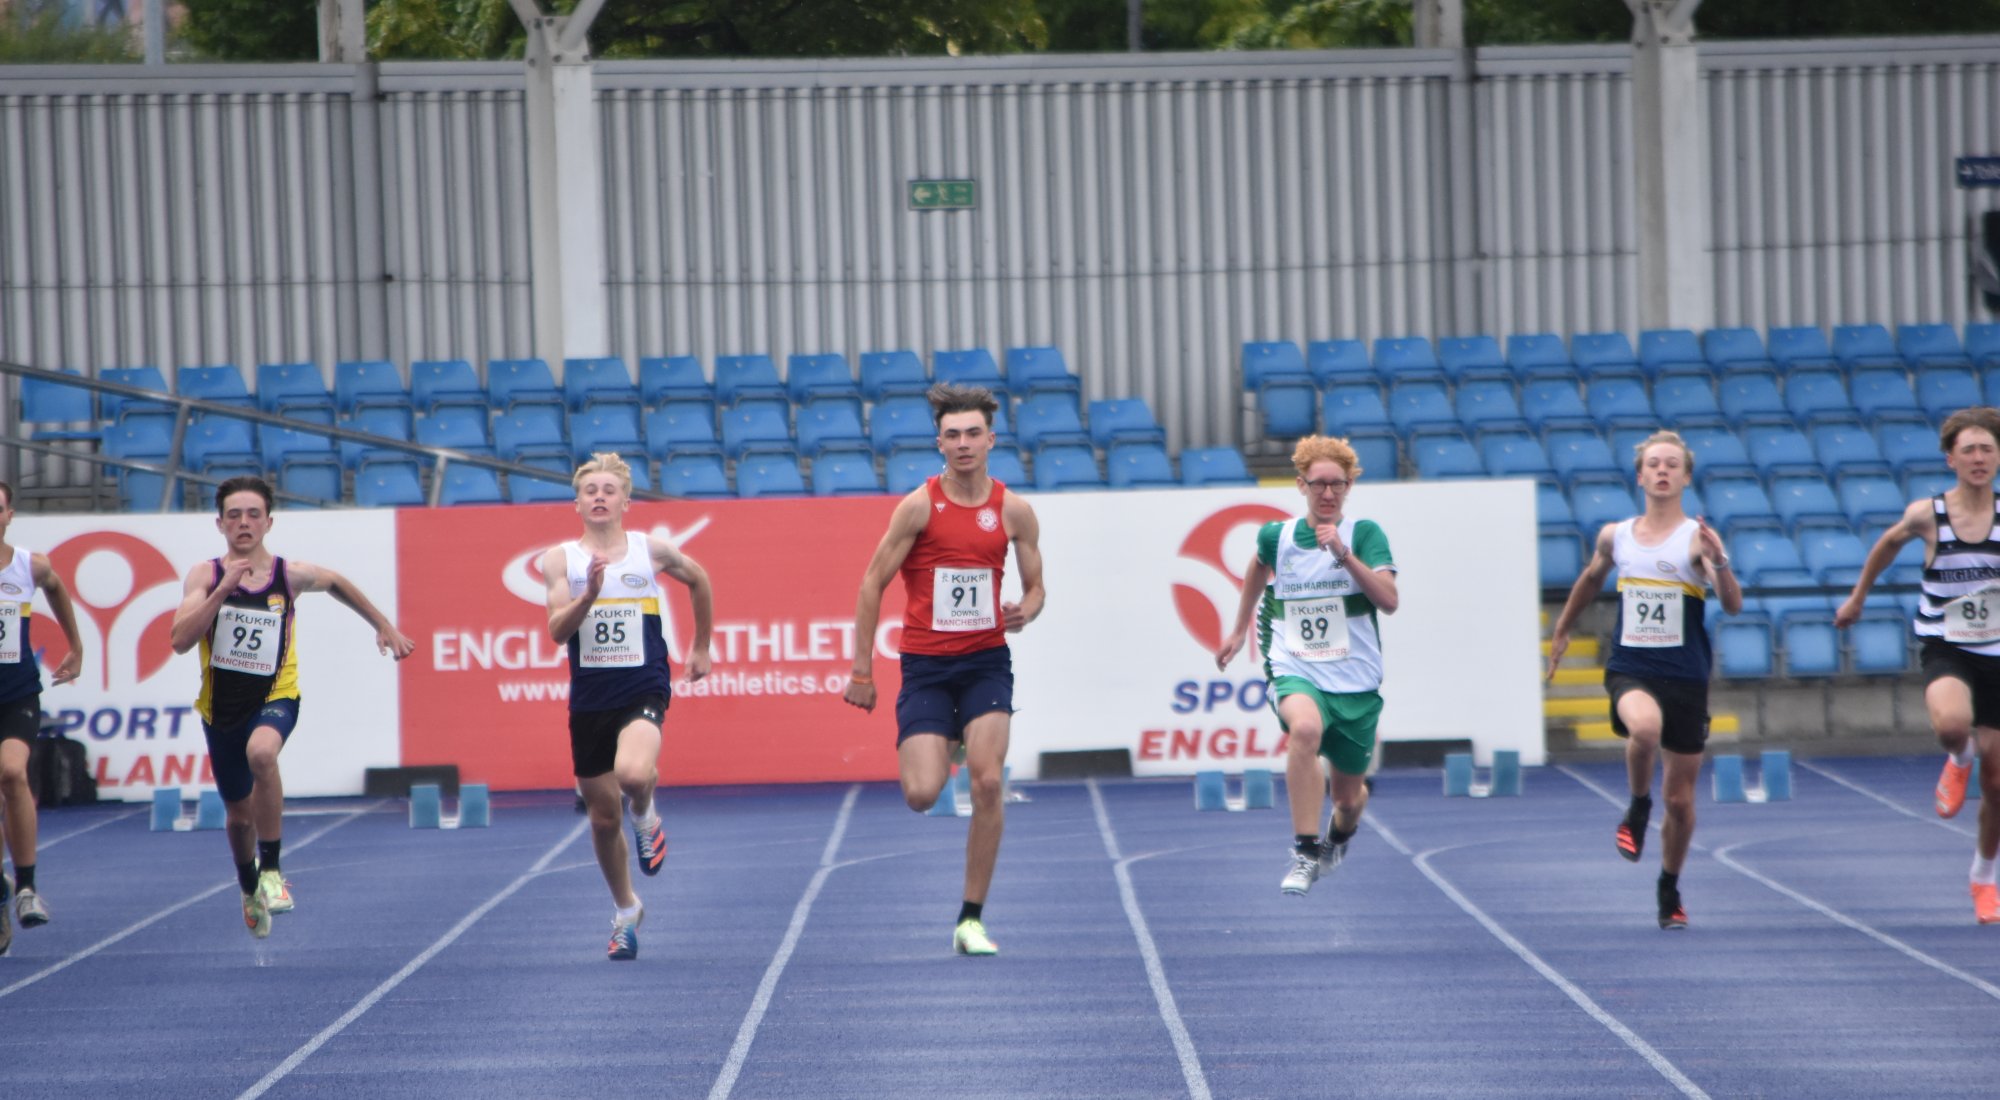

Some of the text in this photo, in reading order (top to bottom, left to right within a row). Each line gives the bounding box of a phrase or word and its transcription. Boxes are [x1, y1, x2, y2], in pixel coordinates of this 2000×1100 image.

[951, 574, 988, 583] KUKRI
[1304, 580, 1350, 591] HARRIERS
[951, 586, 977, 608] 91
[1636, 590, 1677, 600] KUKRI
[594, 609, 636, 619] KUKRI
[1297, 604, 1338, 615] KUKRI
[1636, 602, 1666, 625] 94
[1962, 599, 1988, 620] 86
[235, 613, 276, 627] KUKRI
[937, 617, 992, 627] MANCHESTER
[594, 622, 626, 644] 85
[1300, 617, 1328, 640] 89
[232, 626, 263, 651] 95
[706, 620, 904, 663] THLETC
[230, 649, 258, 660] MOBBS
[592, 646, 630, 654] HOWARTH
[214, 655, 272, 671] MANCHESTER
[583, 654, 640, 663] MANCHESTER
[1171, 679, 1267, 714] SPO
